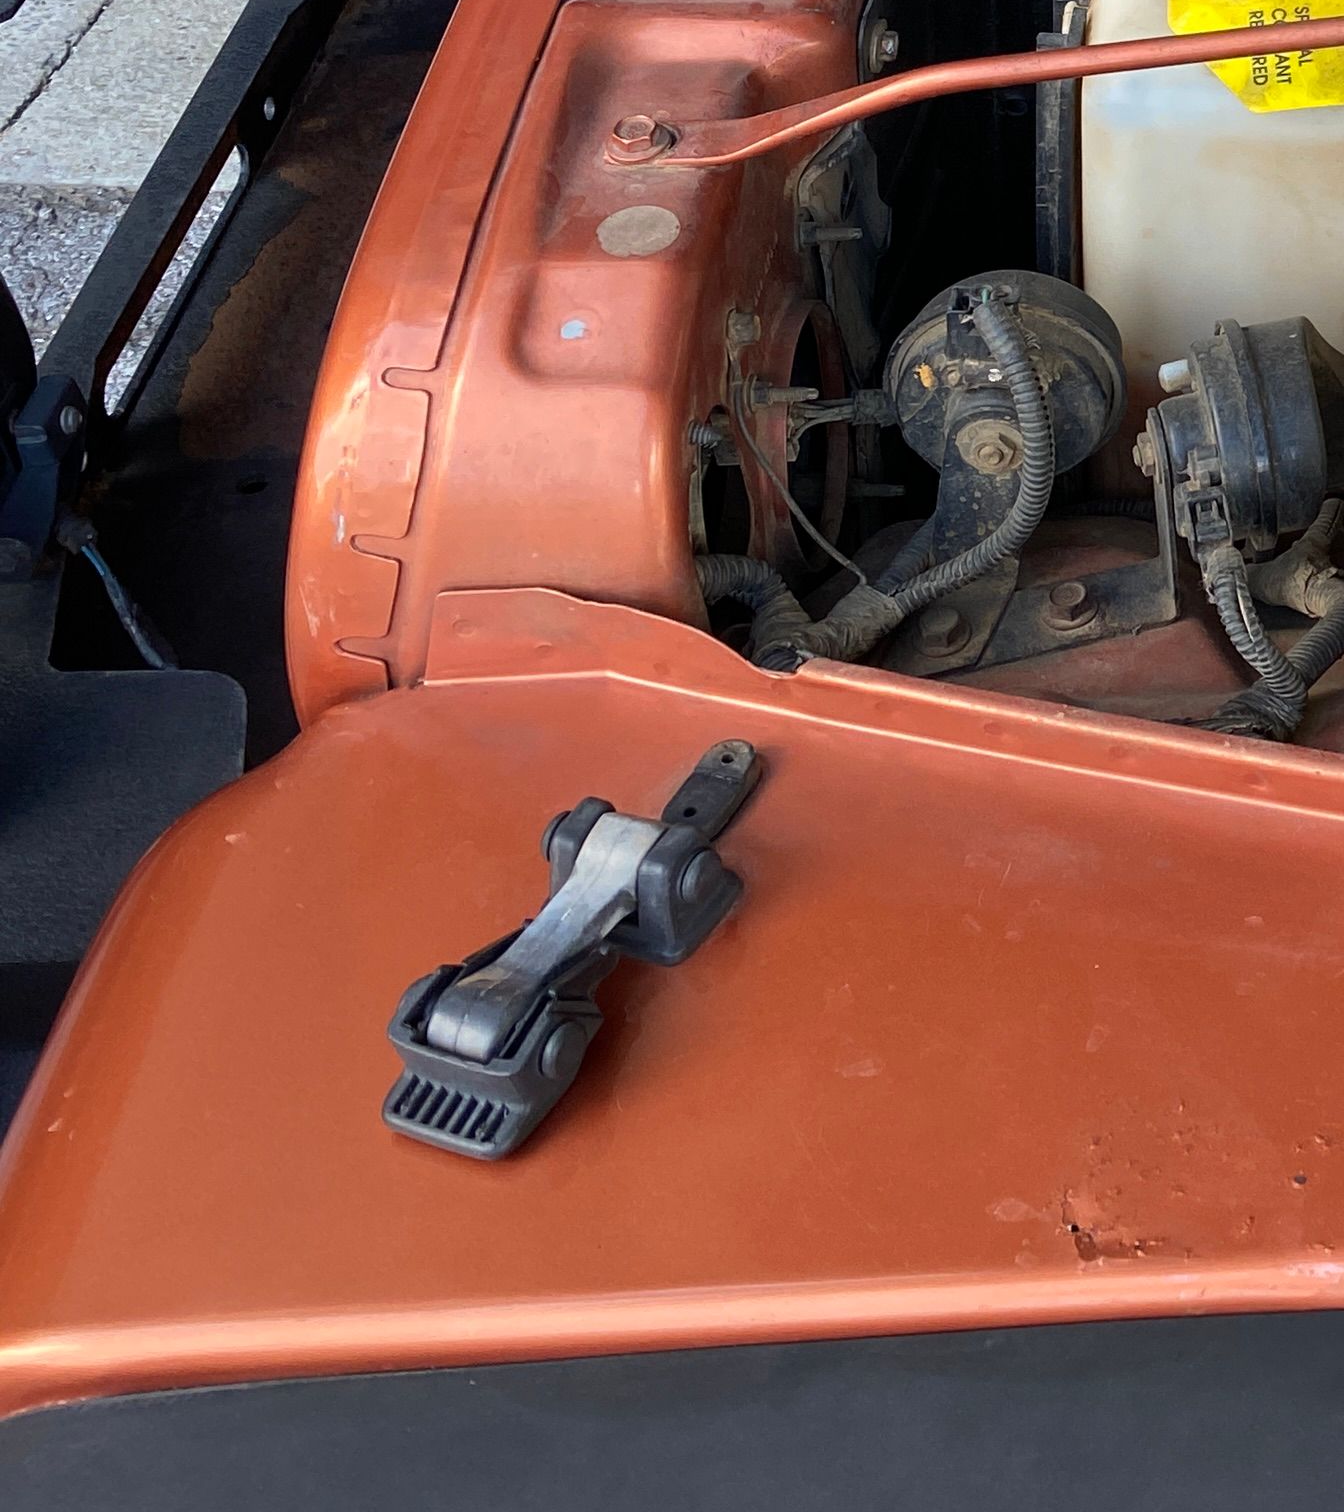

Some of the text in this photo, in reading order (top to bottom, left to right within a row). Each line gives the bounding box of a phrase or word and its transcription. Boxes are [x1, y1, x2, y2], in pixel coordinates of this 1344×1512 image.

[1248, 10, 1269, 86] RERED
[1271, 8, 1292, 85] CANT
[1294, 6, 1314, 67] SPAL
